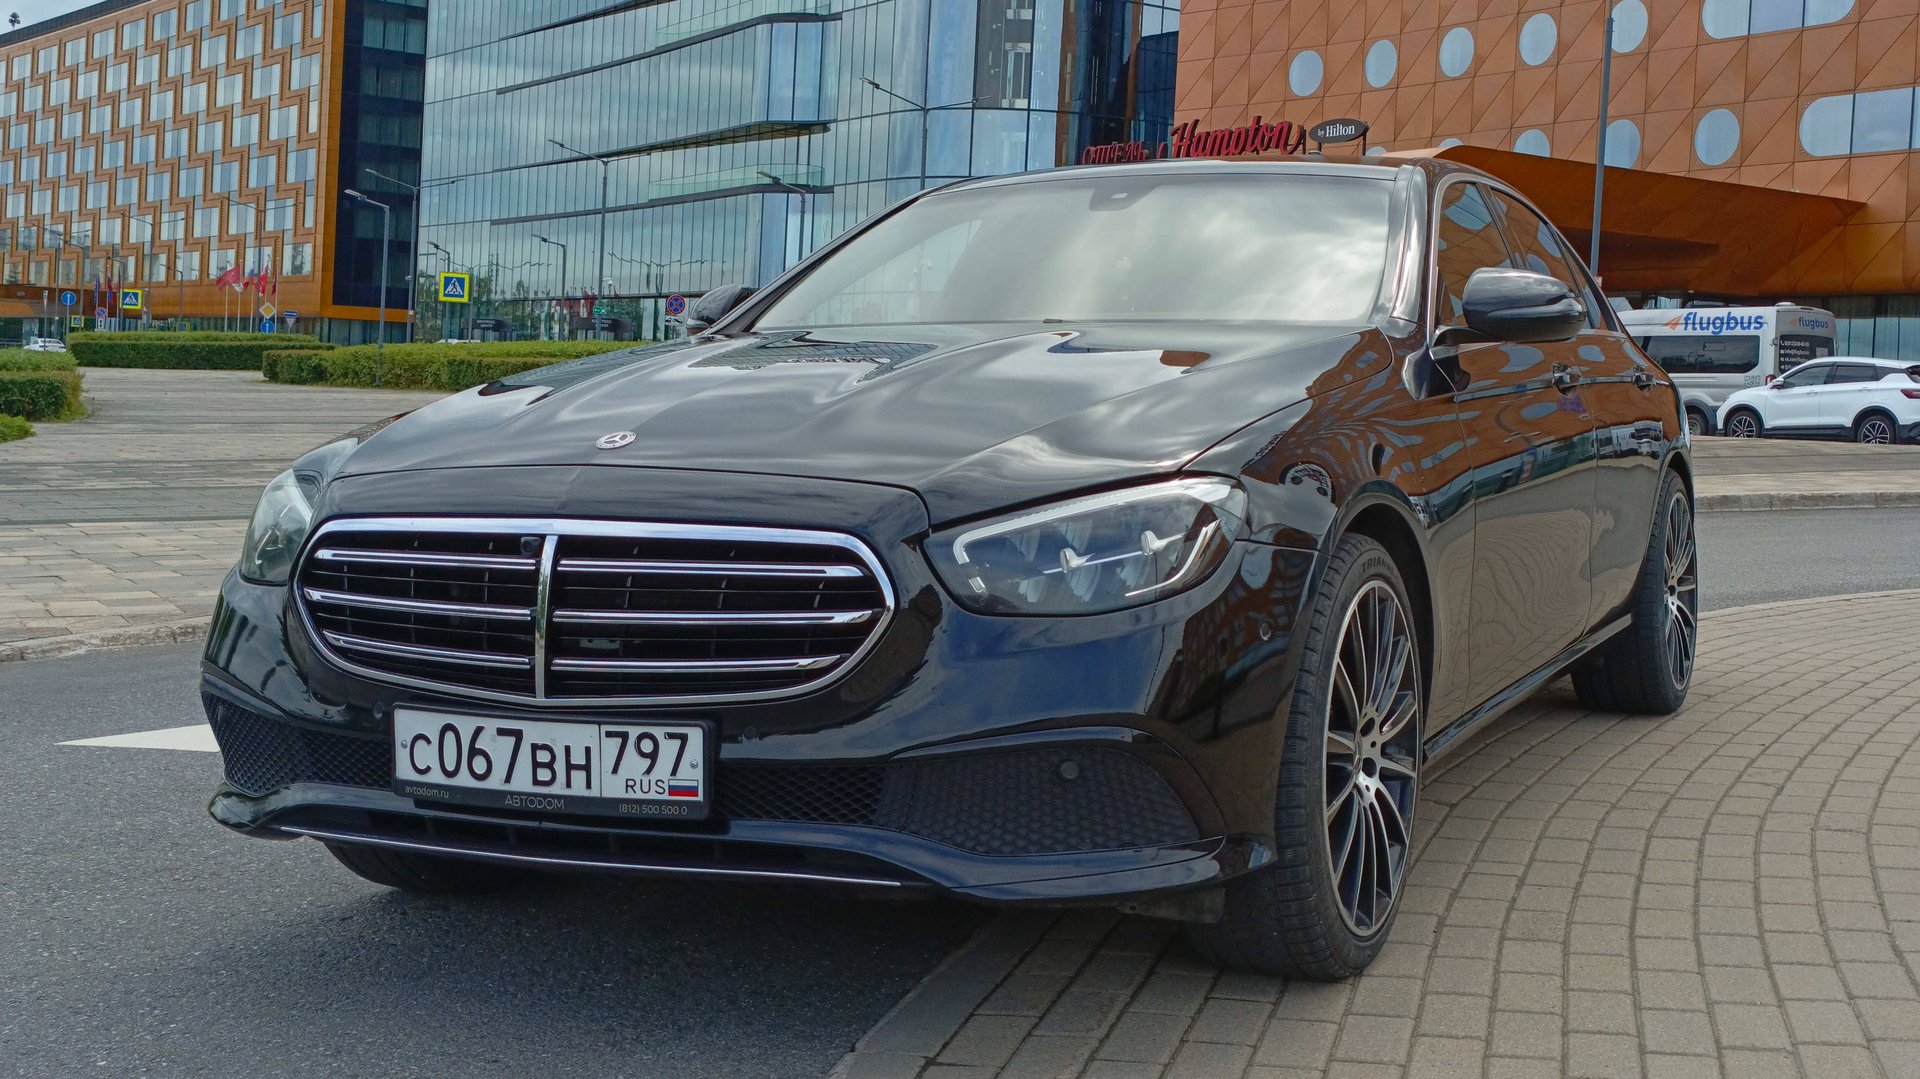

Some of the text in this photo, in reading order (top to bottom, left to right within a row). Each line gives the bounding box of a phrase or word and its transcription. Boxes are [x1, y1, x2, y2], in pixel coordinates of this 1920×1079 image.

[1168, 115, 1306, 158] Hampton
[1325, 123, 1355, 138] Hilton
[1683, 311, 1764, 335] flugbus
[1798, 316, 1829, 330] flugbus
[604, 730, 689, 777] 797
[404, 784, 450, 799] avtodom.ru
[625, 778, 666, 795] RUS
[619, 803, 688, 815] (812) 500 500 0
